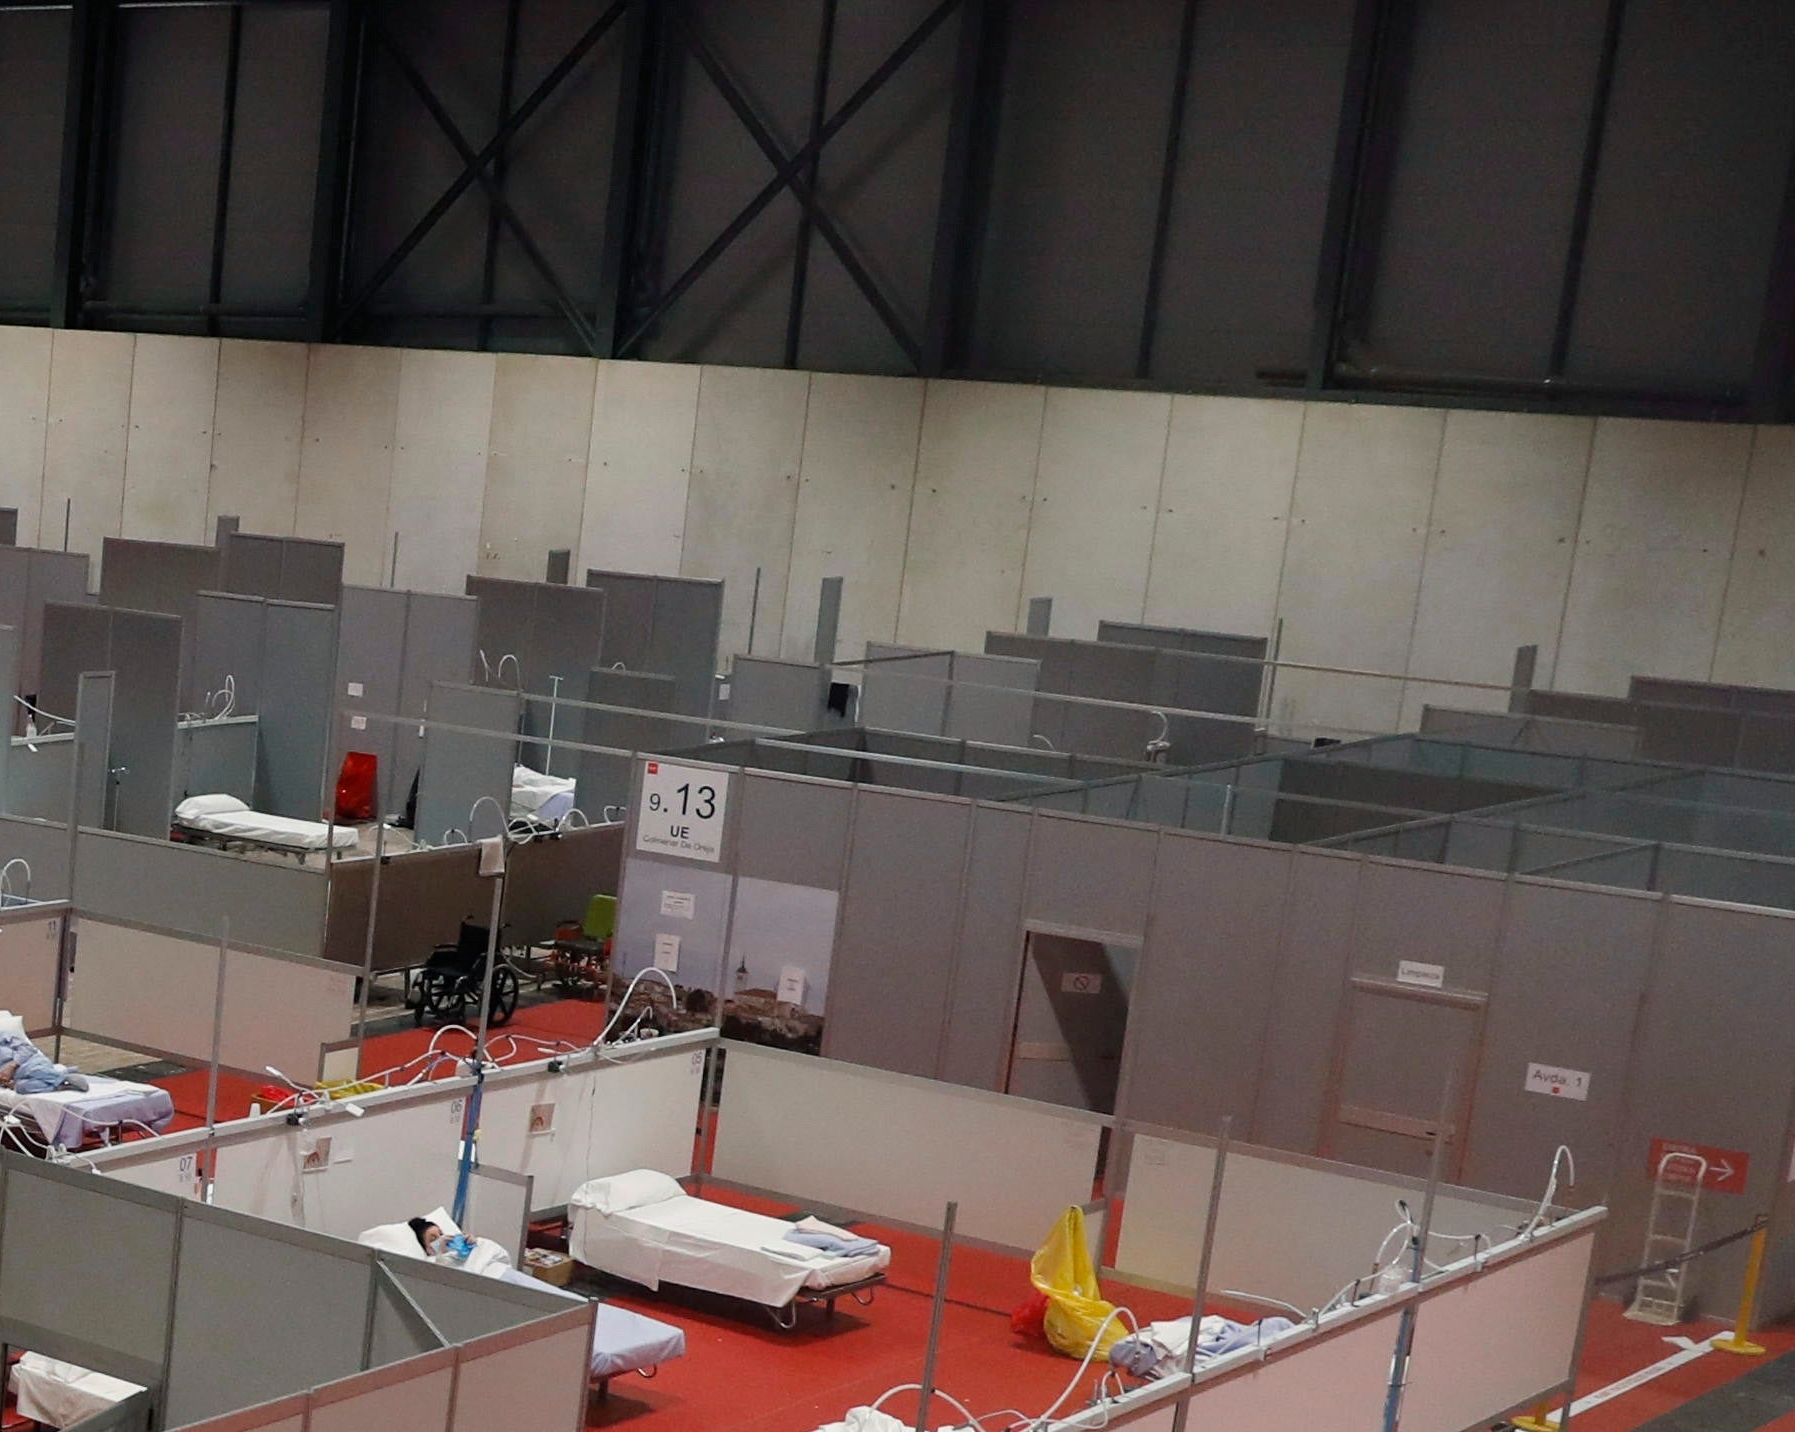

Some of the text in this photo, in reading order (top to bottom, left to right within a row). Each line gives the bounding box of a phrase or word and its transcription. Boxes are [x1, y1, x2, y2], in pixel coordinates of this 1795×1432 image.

[649, 783, 716, 820] 9.13
[670, 825, 690, 840] UE
[179, 1157, 191, 1172] 07
